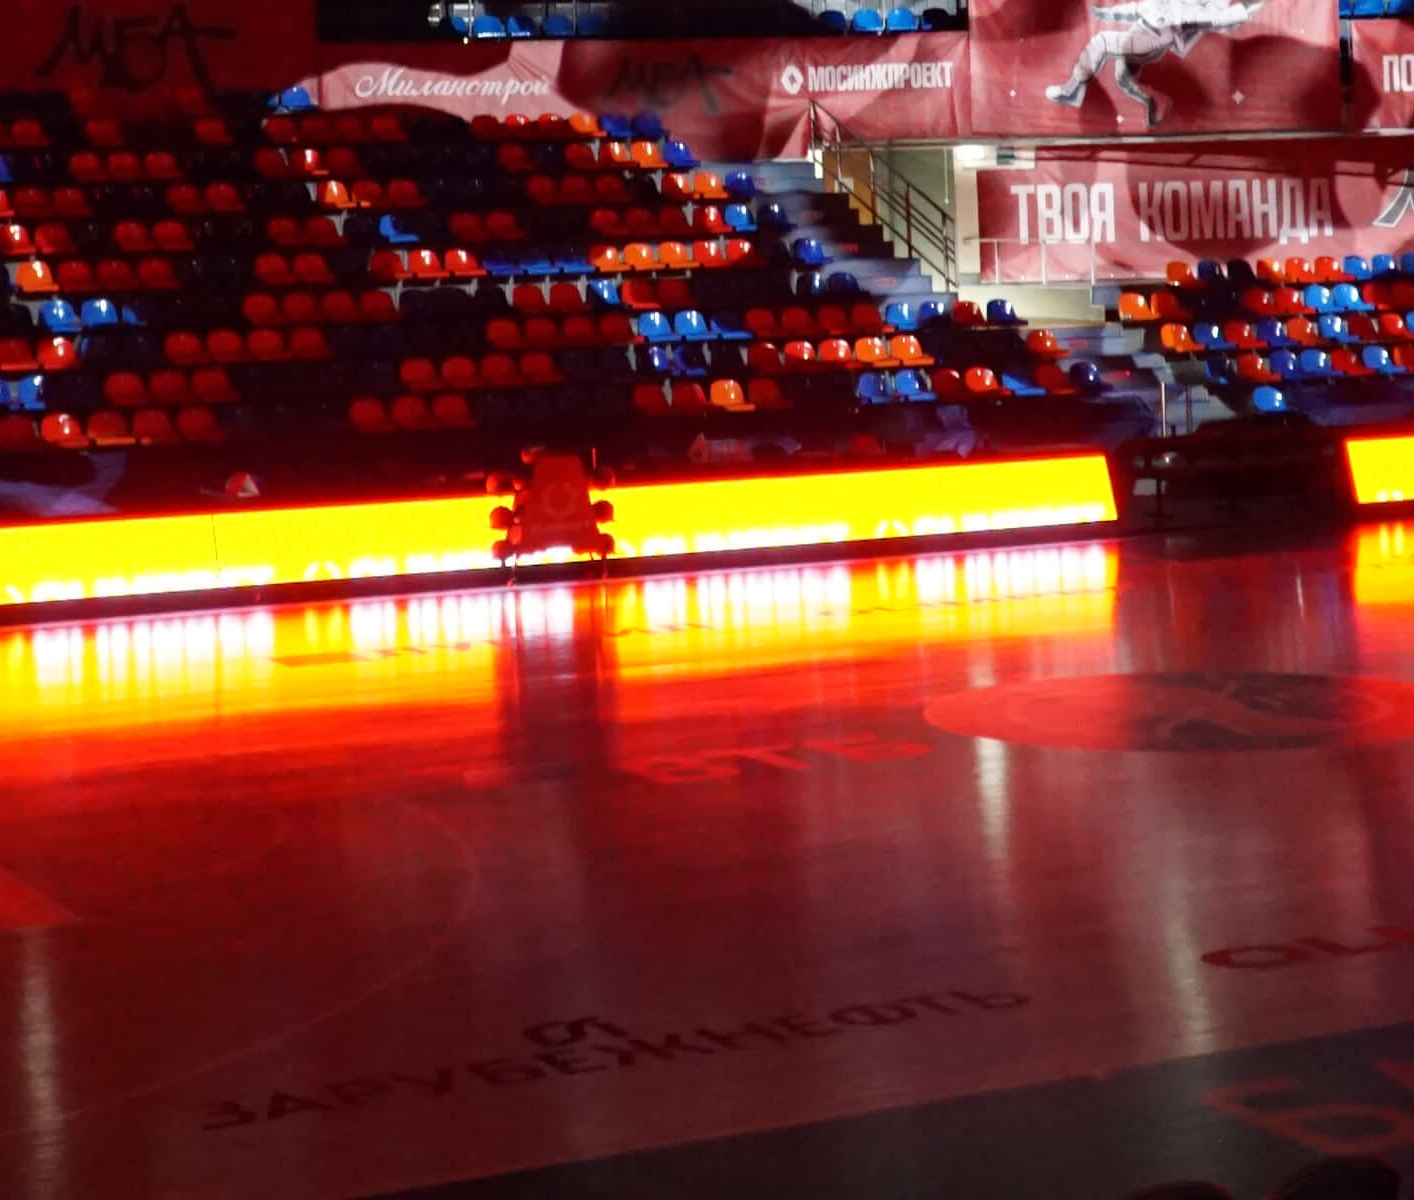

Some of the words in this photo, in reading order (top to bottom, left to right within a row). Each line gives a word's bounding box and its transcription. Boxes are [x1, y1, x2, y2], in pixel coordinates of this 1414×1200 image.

[808, 61, 953, 92] МОСИНЖПРОЕКТ
[1011, 182, 1116, 246] ТВОЯ
[1137, 178, 1334, 246] КОМАНДА
